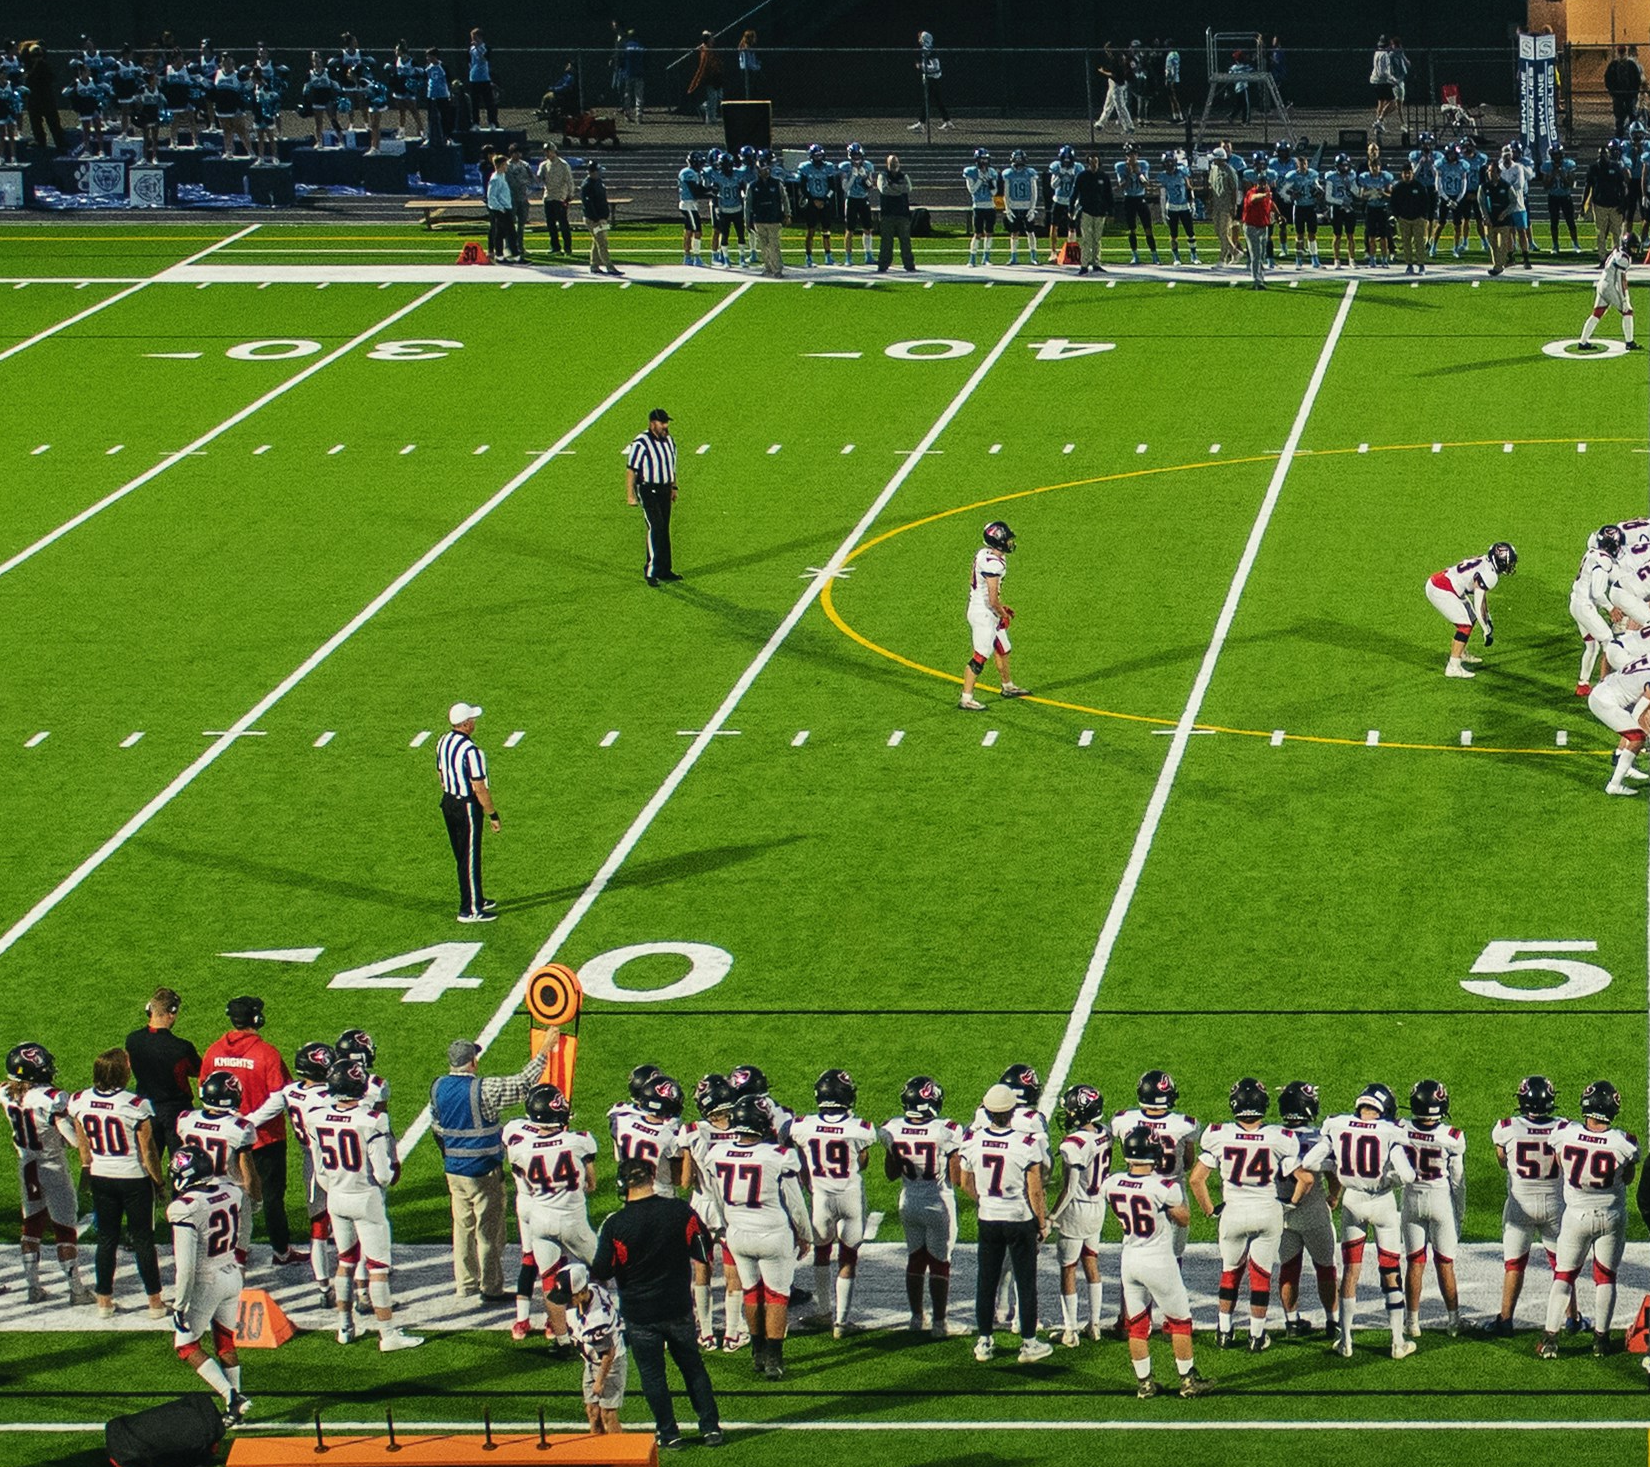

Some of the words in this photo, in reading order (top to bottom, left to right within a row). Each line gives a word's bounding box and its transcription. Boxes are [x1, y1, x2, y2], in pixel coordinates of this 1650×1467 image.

[1012, 181, 1026, 198] 19
[463, 246, 478, 262] 30
[326, 940, 734, 1002] 40
[213, 1057, 255, 1070] KNIGHTS
[80, 1115, 131, 1158] 80
[315, 1128, 364, 1173] 50
[531, 1139, 563, 1149] KNIGHTS
[1337, 1131, 1381, 1179] 10
[1579, 1134, 1608, 1144] KNIGHTS
[527, 1150, 580, 1193] 44
[807, 1138, 851, 1179] 19
[982, 1153, 1005, 1197] 7
[1223, 1145, 1273, 1188] 74
[1516, 1139, 1559, 1181] 57
[1563, 1146, 1616, 1190] 79
[716, 1162, 762, 1208] 77
[206, 1203, 241, 1257] 21
[1109, 1193, 1155, 1238] 56
